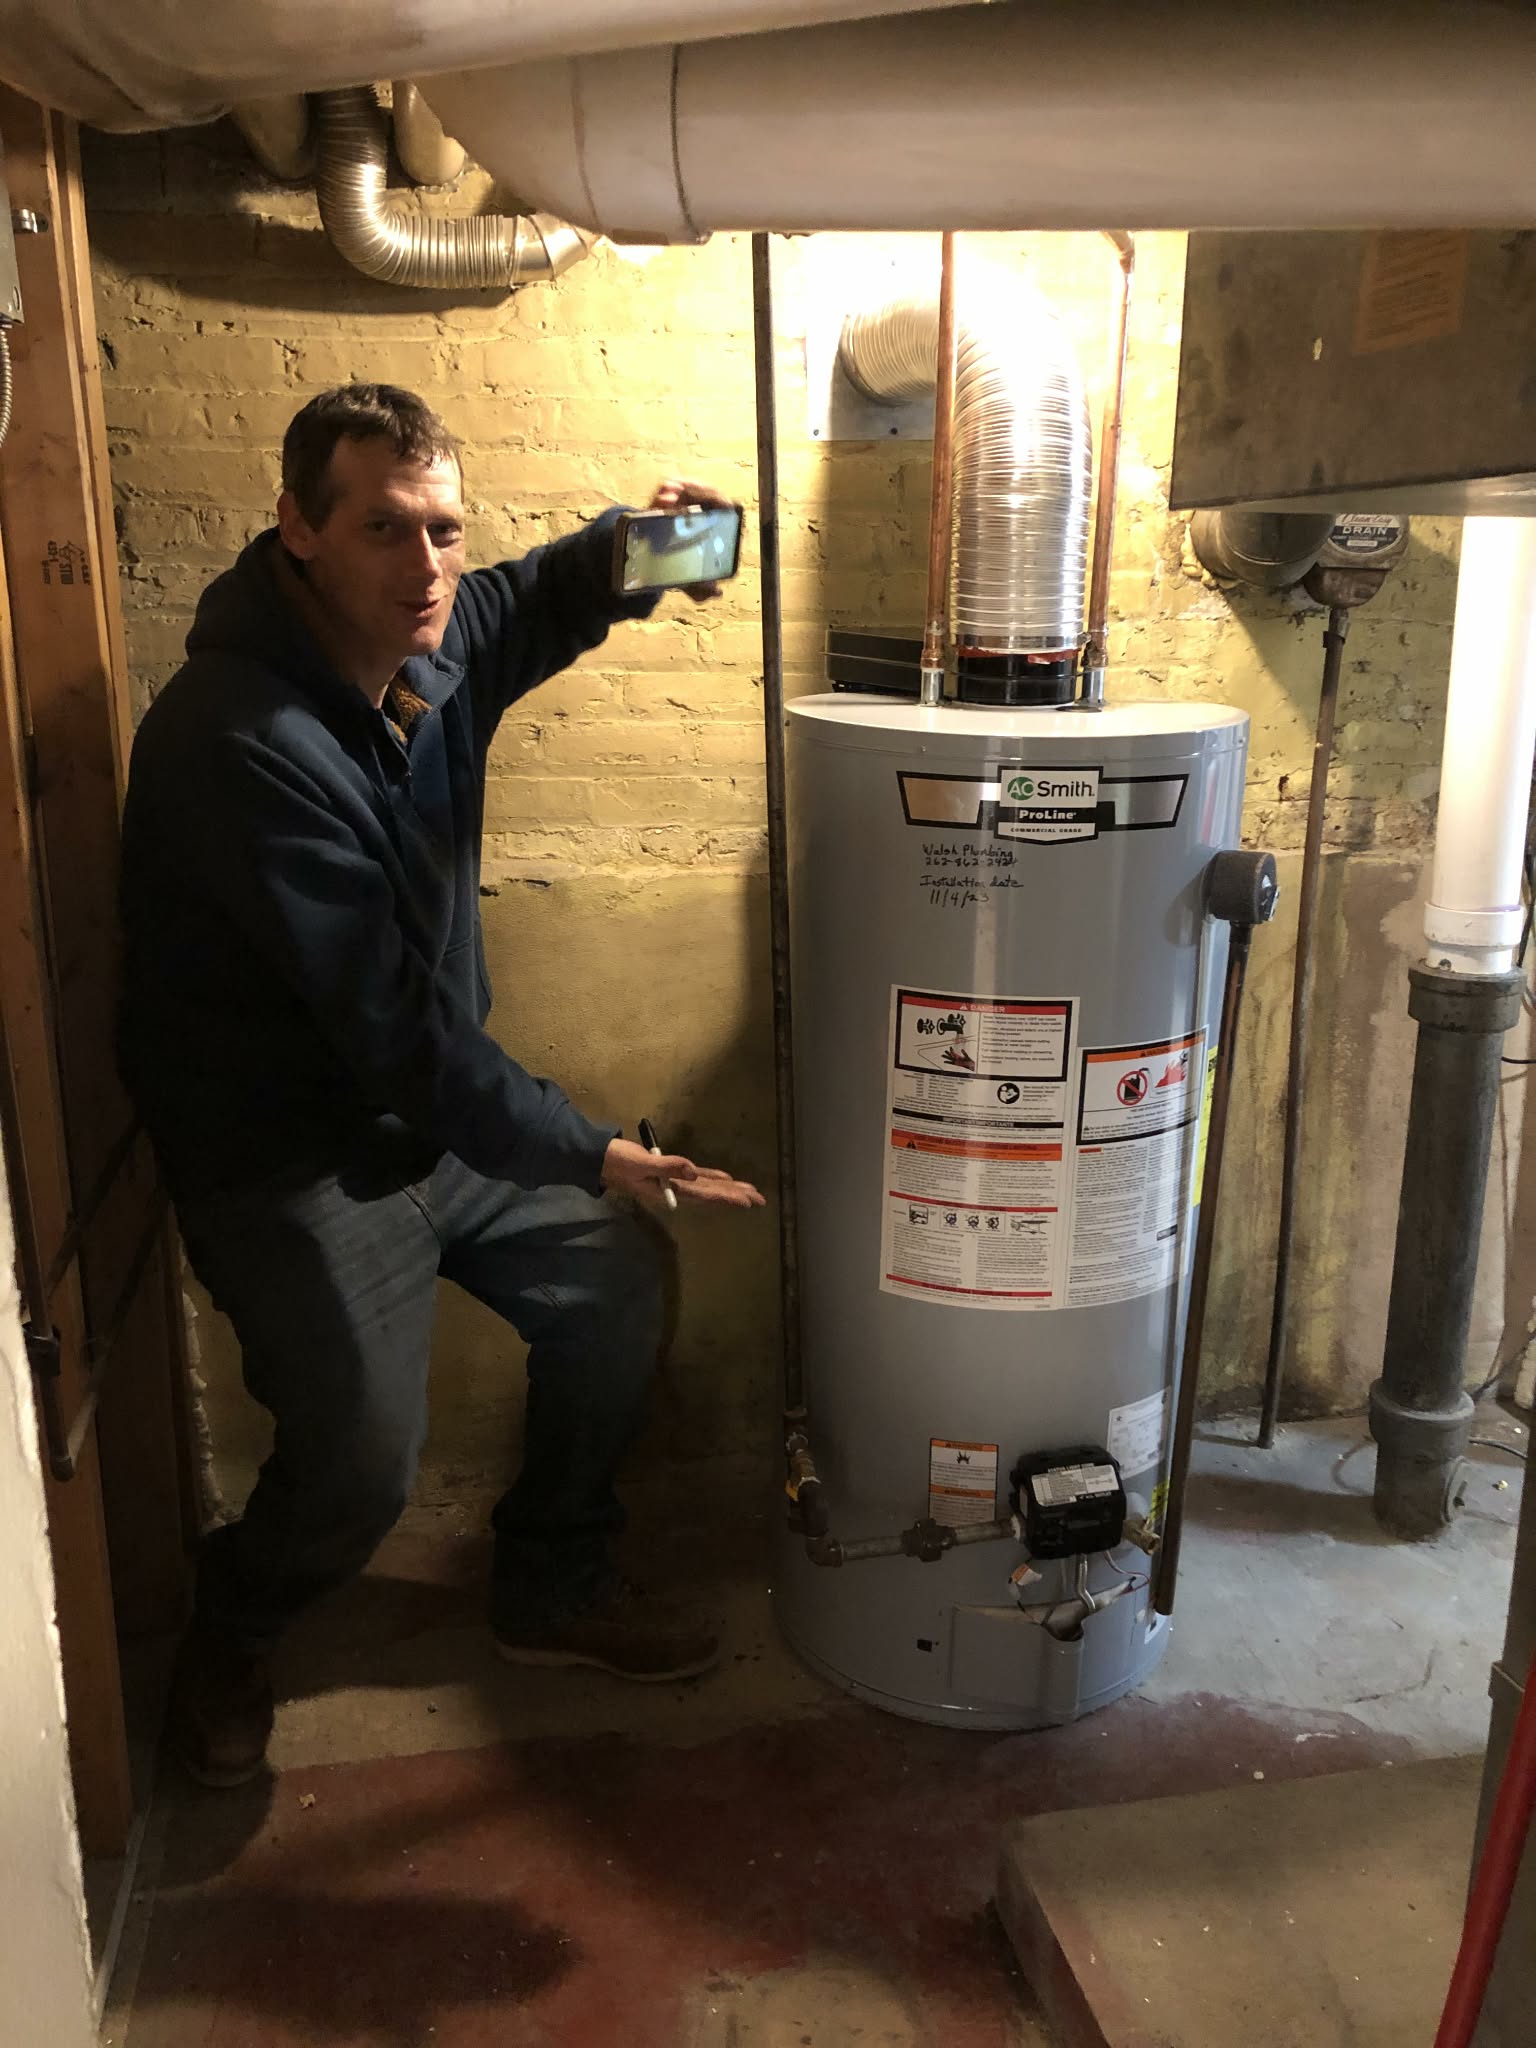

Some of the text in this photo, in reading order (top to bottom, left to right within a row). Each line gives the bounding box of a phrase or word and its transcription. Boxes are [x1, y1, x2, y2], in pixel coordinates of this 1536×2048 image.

[1343, 525, 1388, 535] DRAIN
[1037, 780, 1093, 797] Smith
[1019, 809, 1074, 820] ProLine
[963, 844, 1013, 859] Plumbing
[990, 874, 1024, 887] date
[969, 1004, 1006, 1014] DANGER
